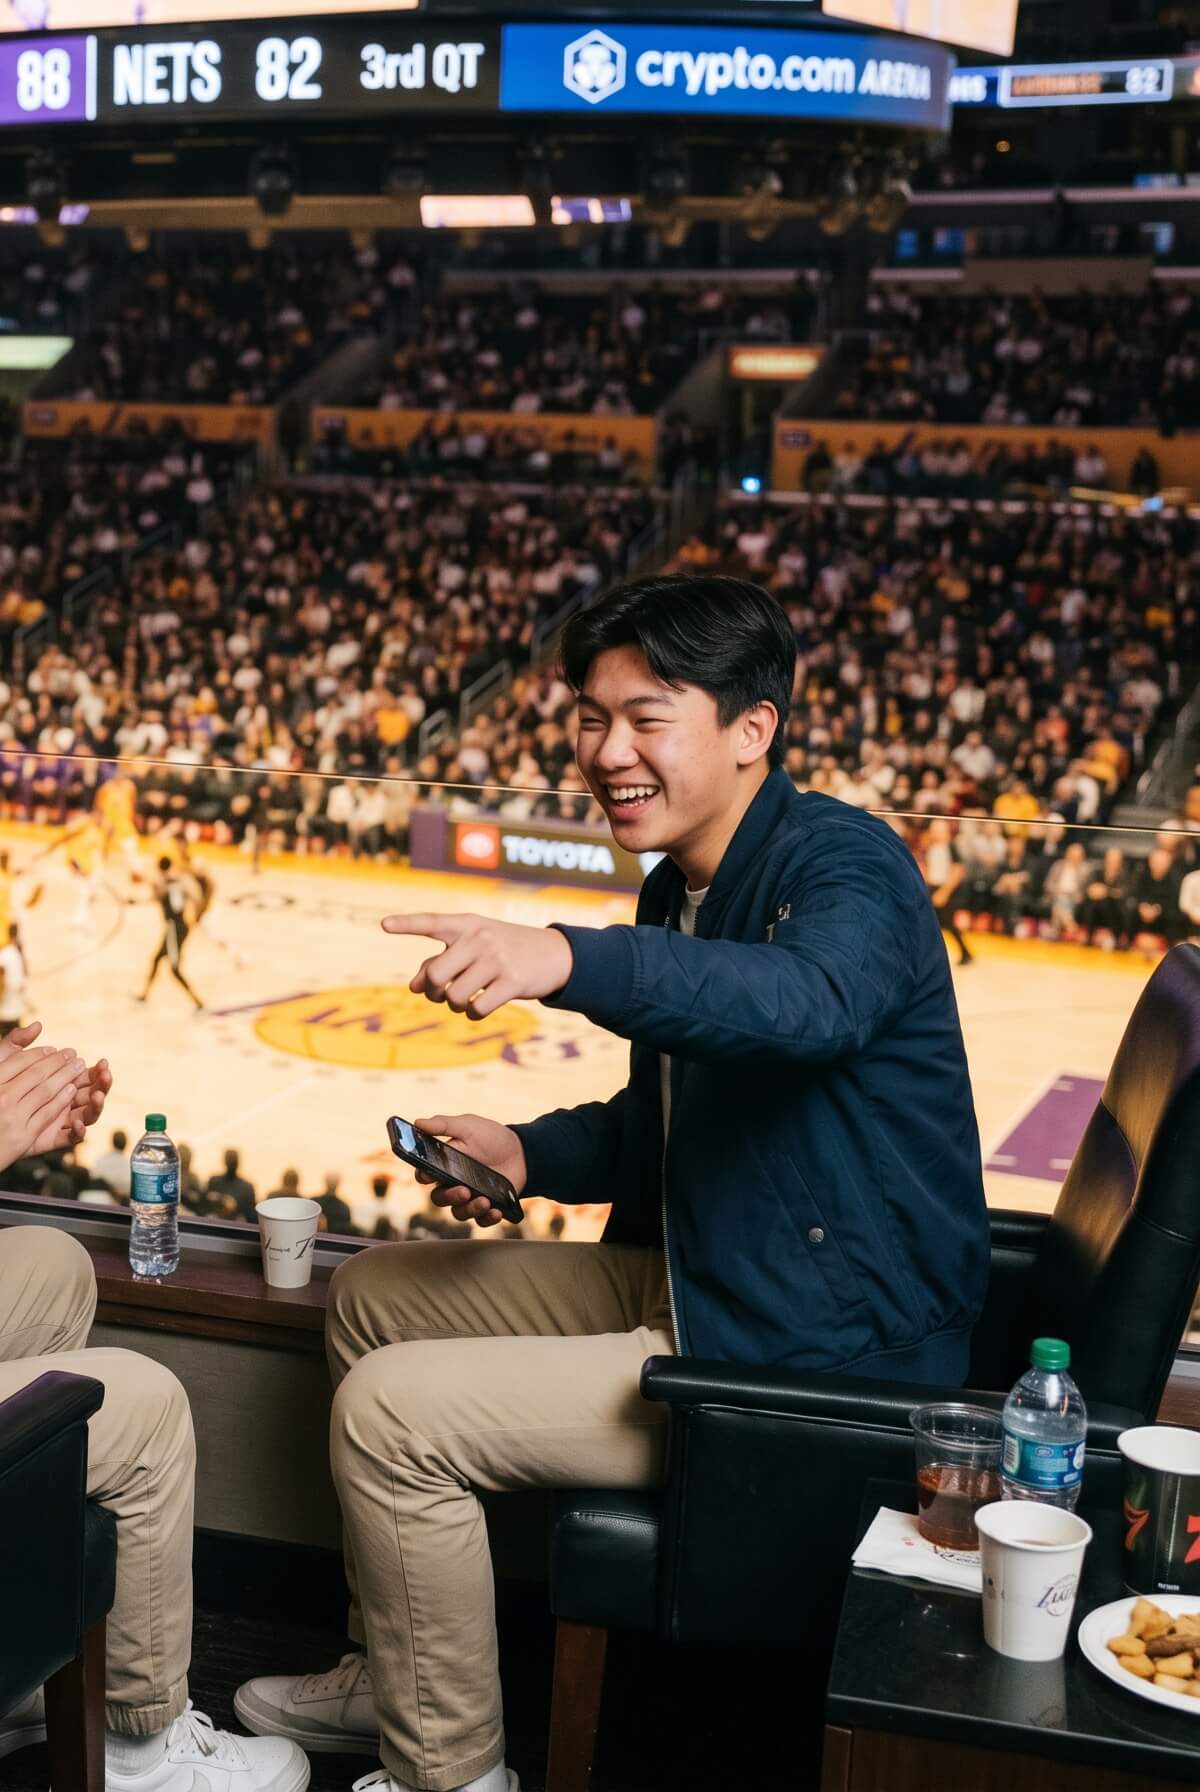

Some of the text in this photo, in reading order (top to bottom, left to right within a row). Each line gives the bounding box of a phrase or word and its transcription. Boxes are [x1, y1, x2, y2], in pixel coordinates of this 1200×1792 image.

[16, 48, 71, 111] 88
[113, 36, 484, 105] NETS 82 3rd QT
[636, 46, 855, 96] crypto.com
[858, 59, 932, 101] ARENA
[502, 835, 615, 874] TOYOTA
